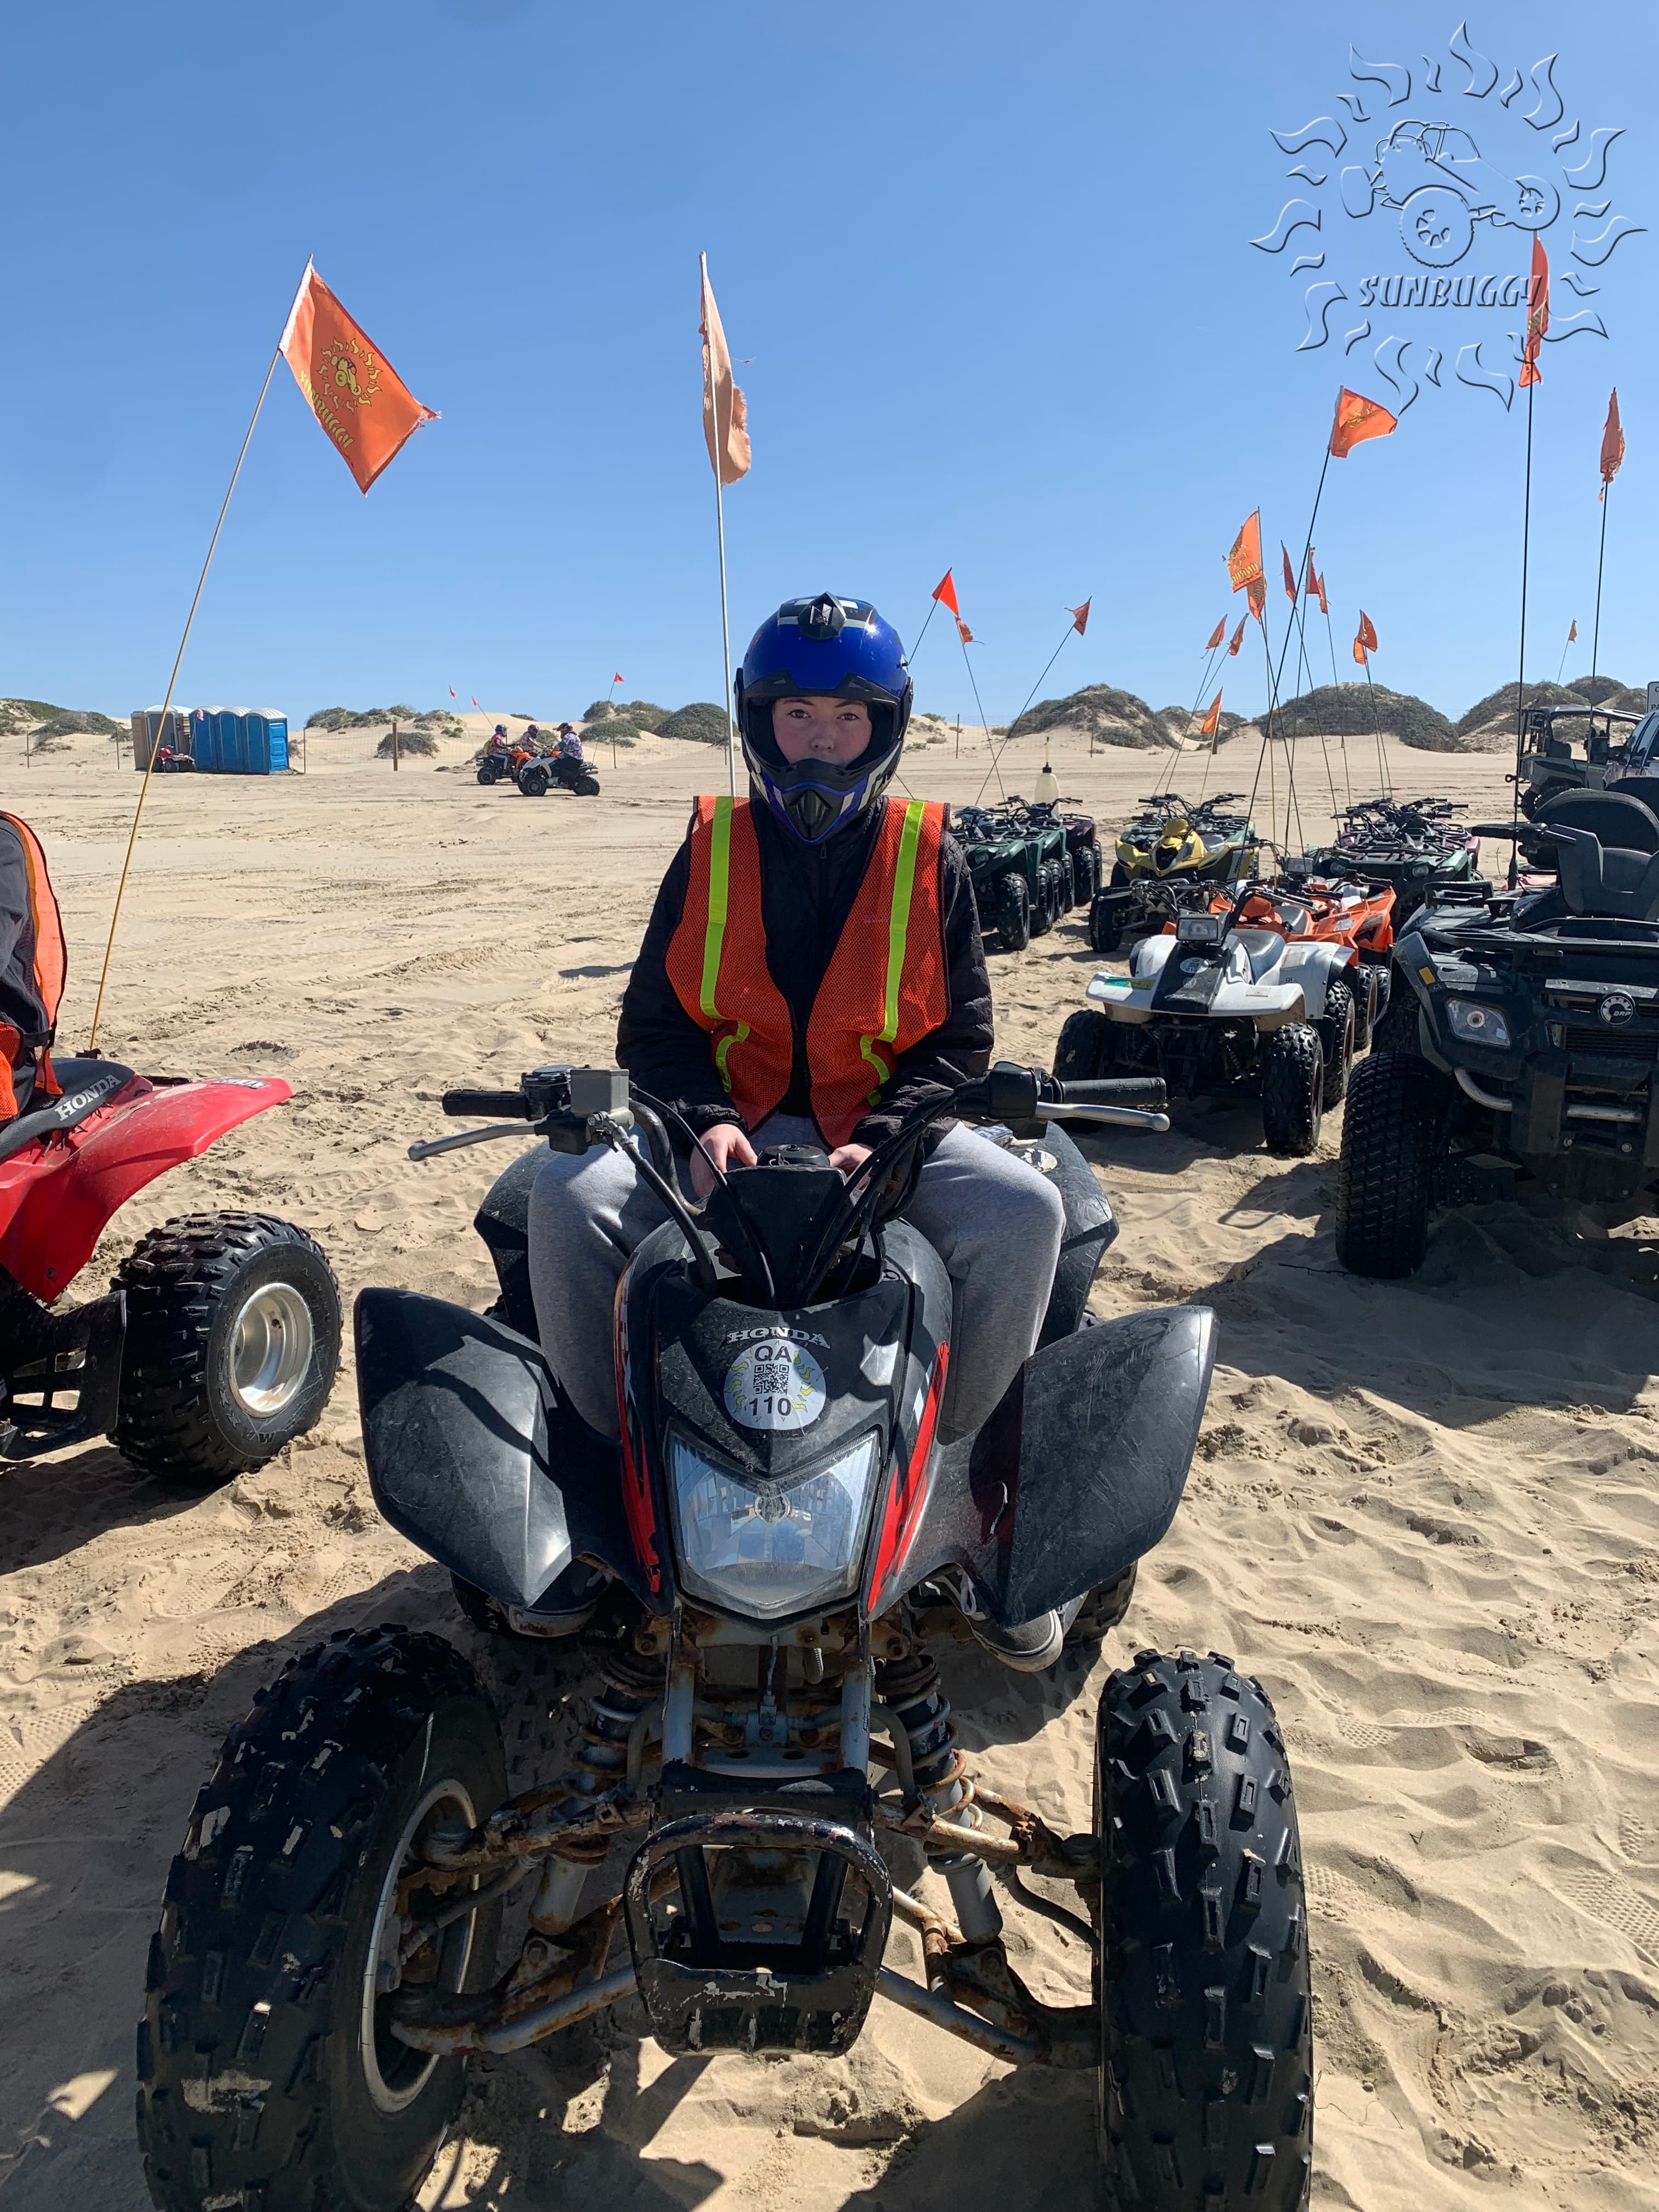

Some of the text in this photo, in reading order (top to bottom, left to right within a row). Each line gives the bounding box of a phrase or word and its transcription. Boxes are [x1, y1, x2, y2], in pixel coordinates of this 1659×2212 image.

[54, 1074, 122, 1121] HONDA
[727, 1327, 831, 1349] HONDA
[754, 1345, 792, 1363] QA
[749, 1397, 791, 1416] 110
